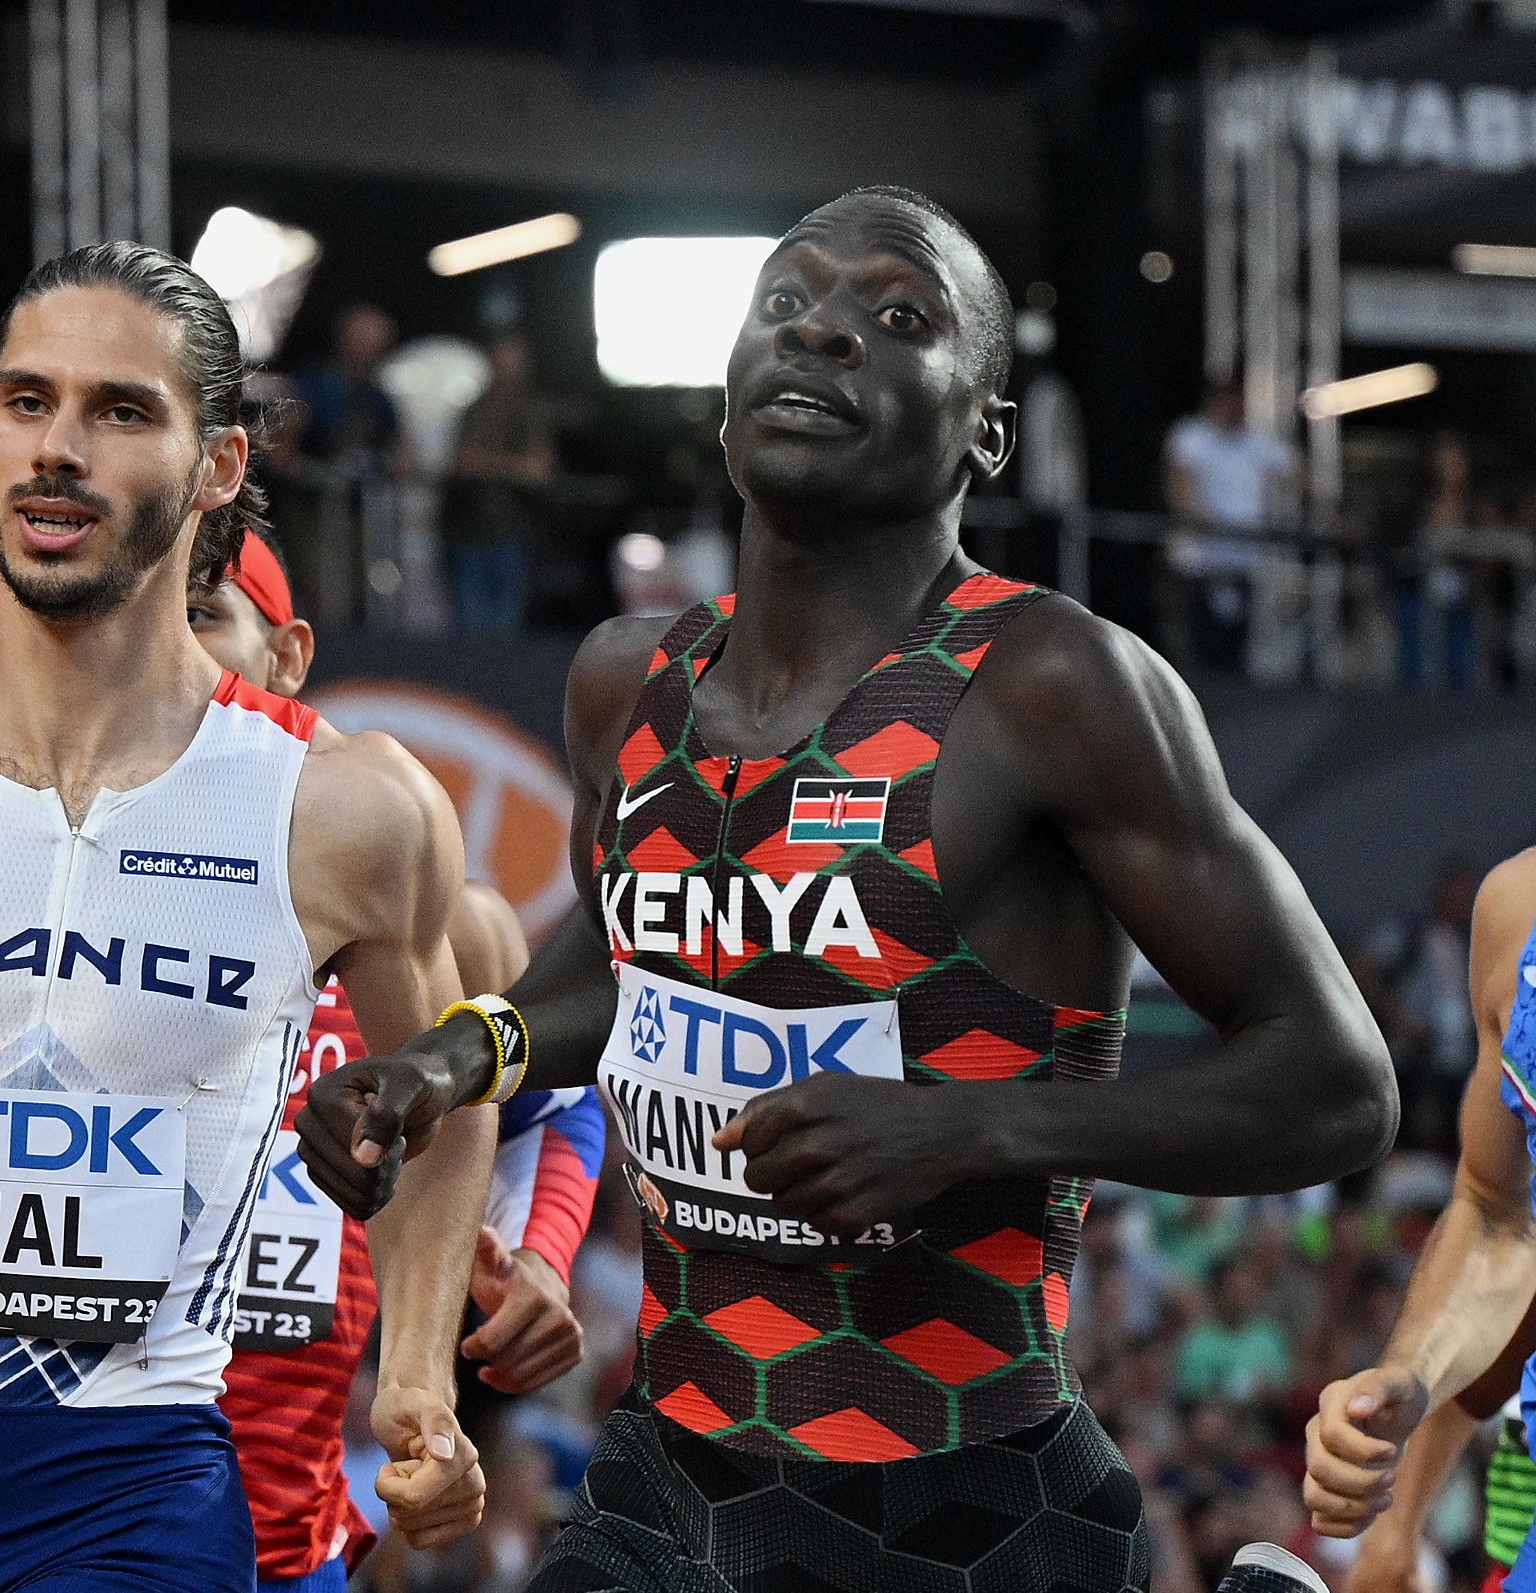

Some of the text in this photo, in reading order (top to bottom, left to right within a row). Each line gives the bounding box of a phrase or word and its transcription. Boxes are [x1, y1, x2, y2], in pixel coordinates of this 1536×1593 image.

[123, 854, 256, 881] Crédit Mutuel
[601, 872, 881, 958] KENYA
[669, 996, 869, 1089] TDK
[124, 1297, 159, 1324] 23
[273, 1313, 312, 1339] 23
